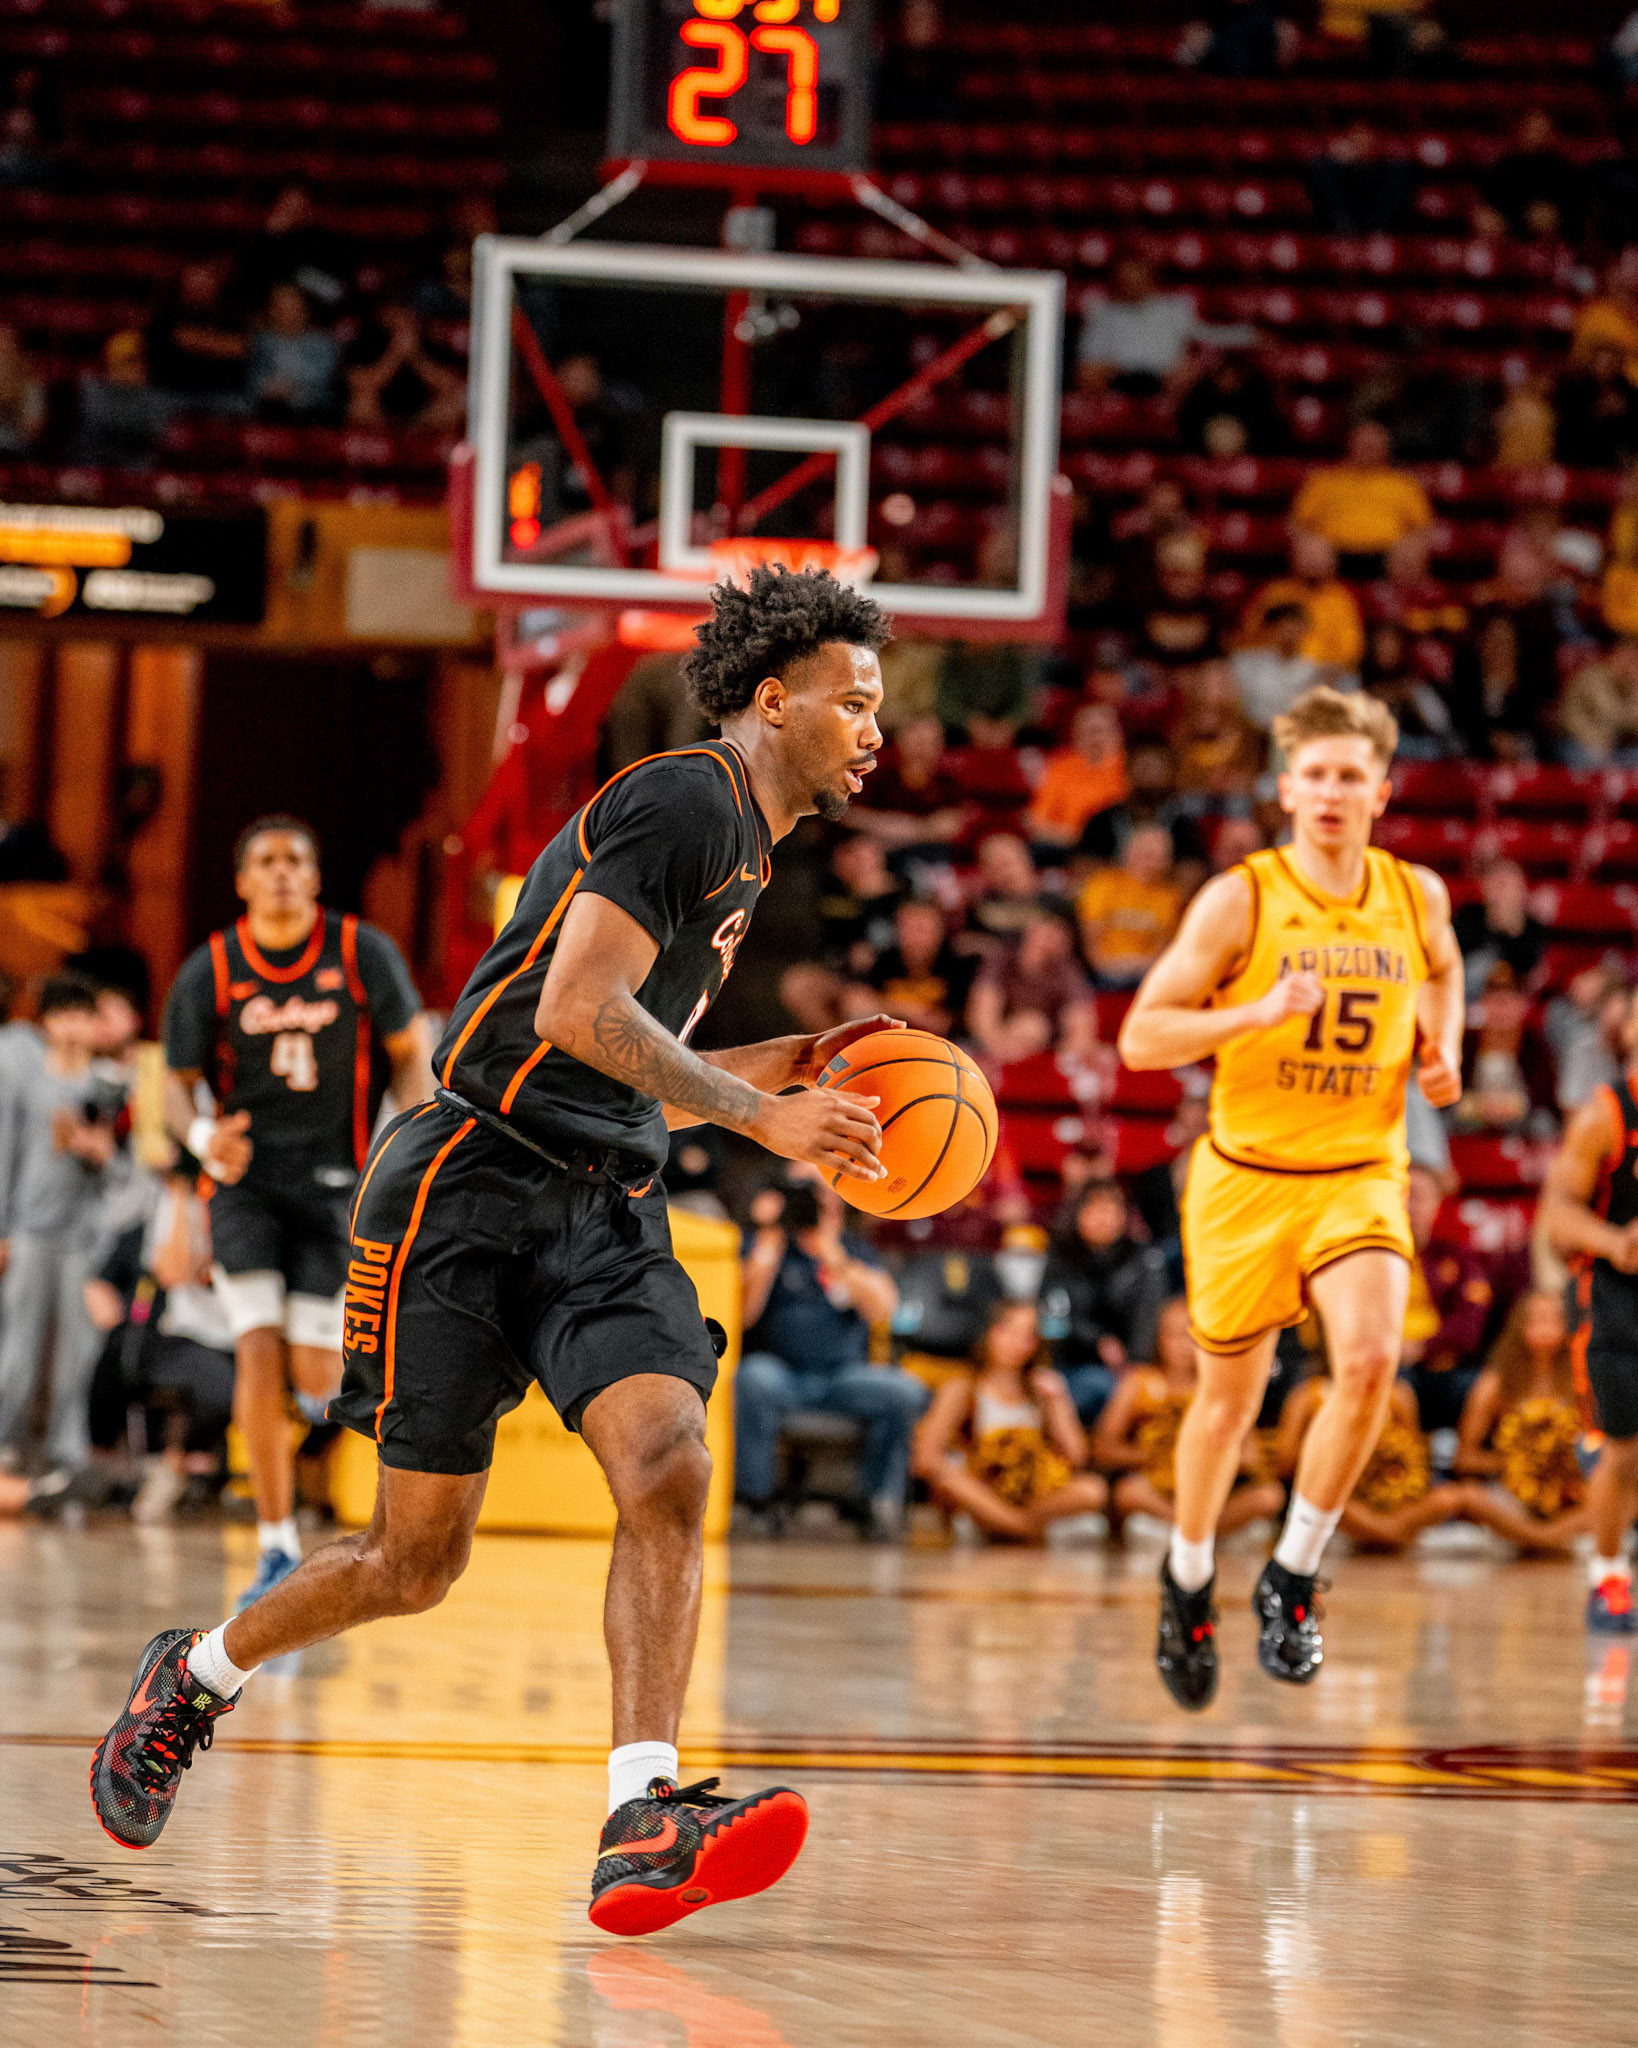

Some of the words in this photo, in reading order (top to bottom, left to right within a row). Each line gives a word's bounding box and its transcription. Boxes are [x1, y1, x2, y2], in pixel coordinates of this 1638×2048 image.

[667, 18, 819, 147] 27
[1279, 946, 1408, 984] ARIZONA
[1303, 990, 1380, 1054] 15
[270, 1033, 318, 1092] 4
[1276, 1058, 1381, 1097] STATE
[344, 1235, 393, 1355] POKES
